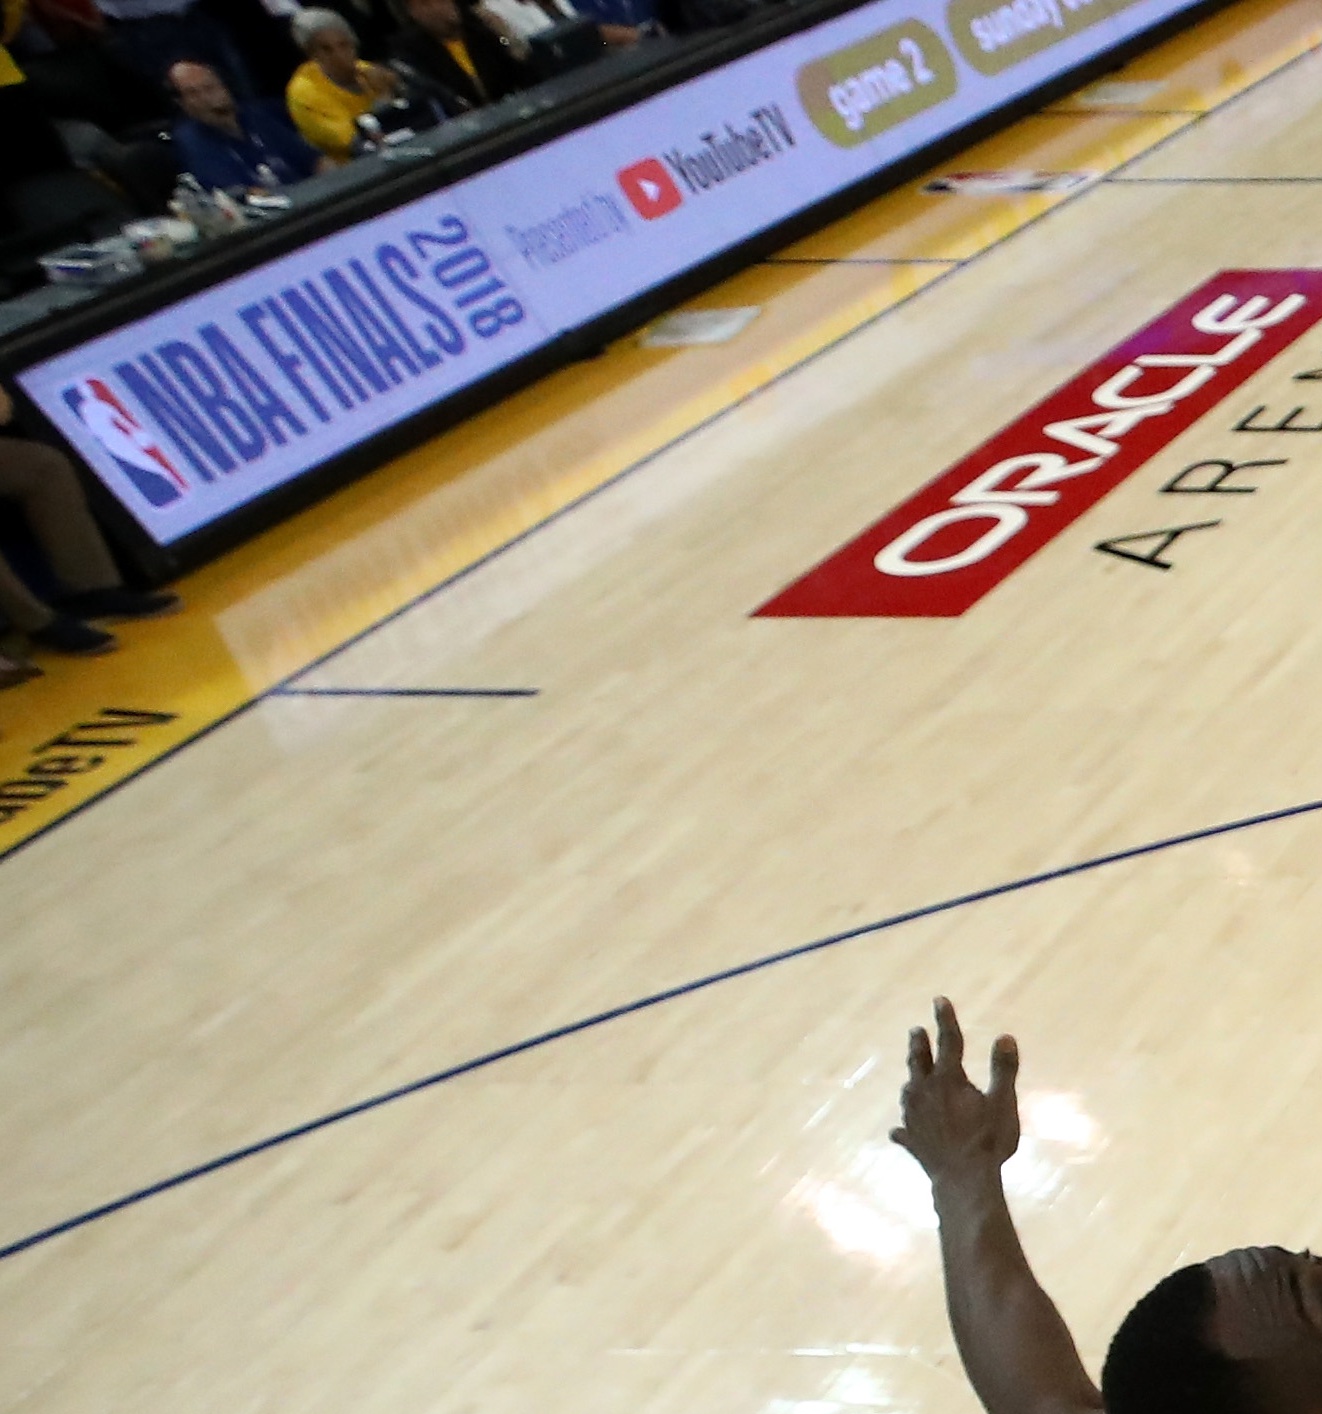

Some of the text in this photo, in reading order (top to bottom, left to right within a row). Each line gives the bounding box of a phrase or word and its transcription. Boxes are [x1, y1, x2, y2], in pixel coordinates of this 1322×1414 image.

[828, 37, 935, 131] game 2
[113, 243, 468, 483] NBA FINALS
[406, 214, 526, 341] 2018
[874, 294, 1306, 577] ORACLE
